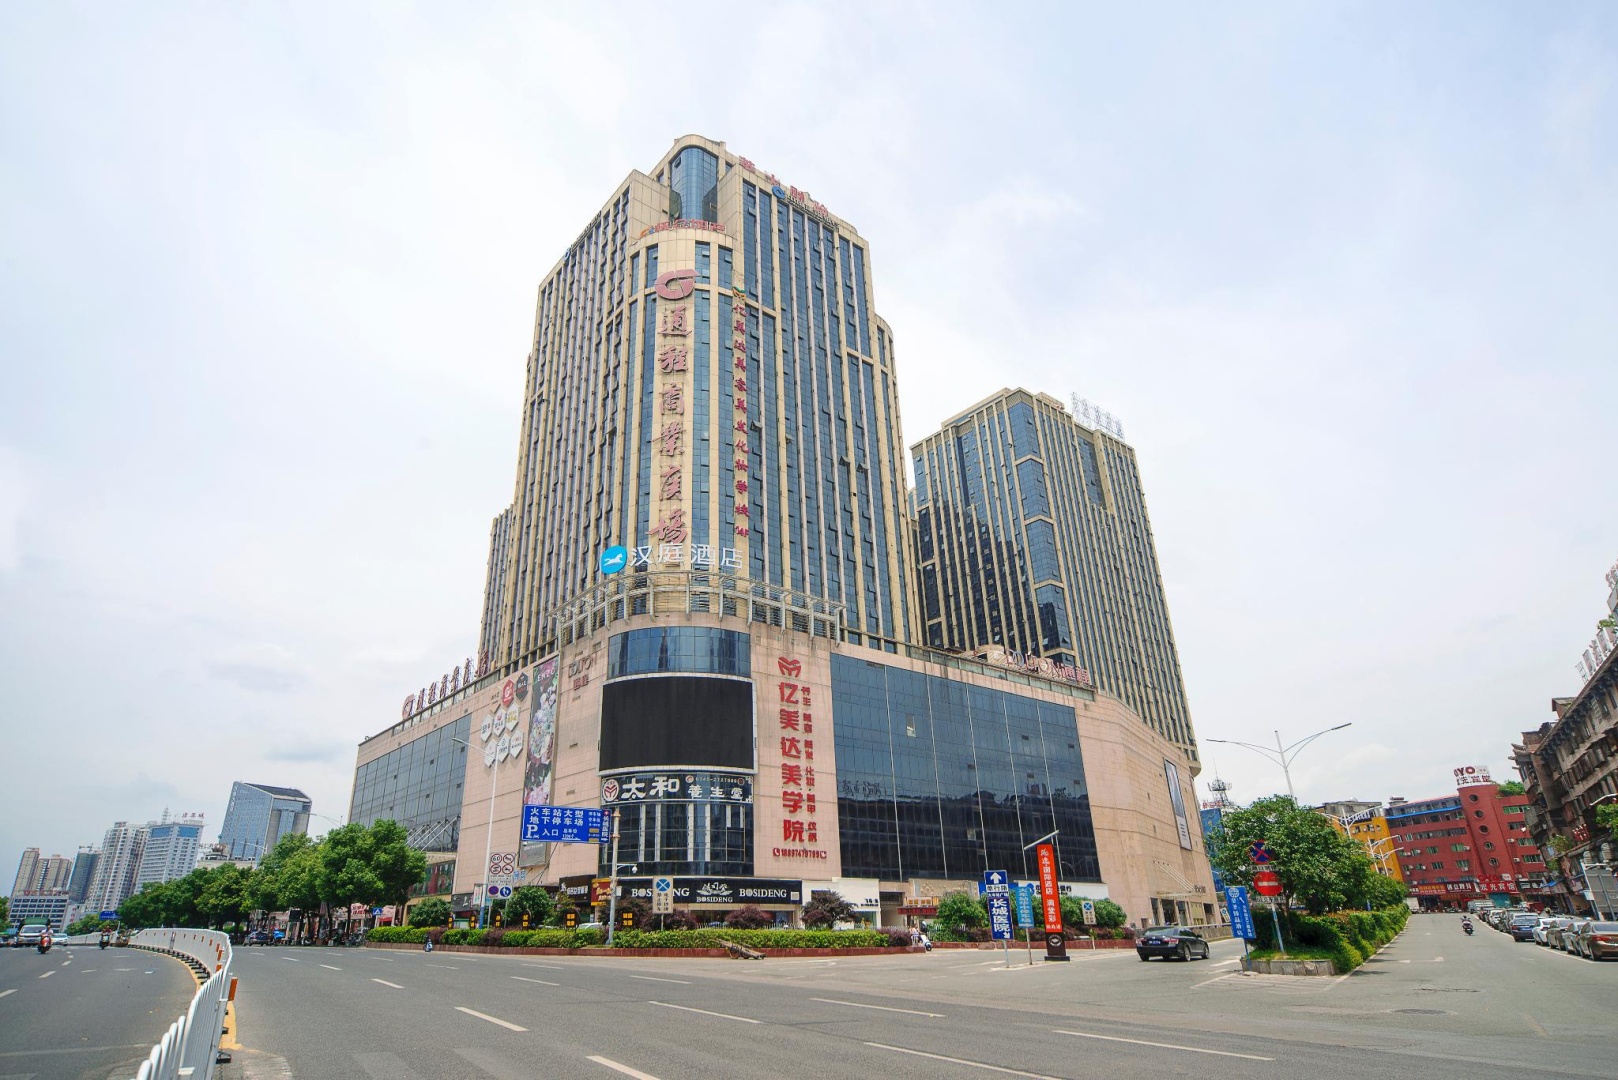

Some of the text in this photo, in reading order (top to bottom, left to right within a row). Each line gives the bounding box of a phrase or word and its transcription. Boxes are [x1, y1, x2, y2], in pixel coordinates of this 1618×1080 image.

[629, 542, 743, 569] 汉庭酒店
[779, 681, 805, 842] 亿美达美学院
[1454, 766, 1476, 777] OYO
[620, 776, 680, 799] 太和
[530, 807, 584, 819] 火车站大型
[529, 816, 584, 827] 地下停车场
[526, 824, 539, 838] P
[631, 888, 690, 898] BOSNG
[739, 888, 787, 898] BOSIDENG
[990, 898, 1011, 932] 长城医院
